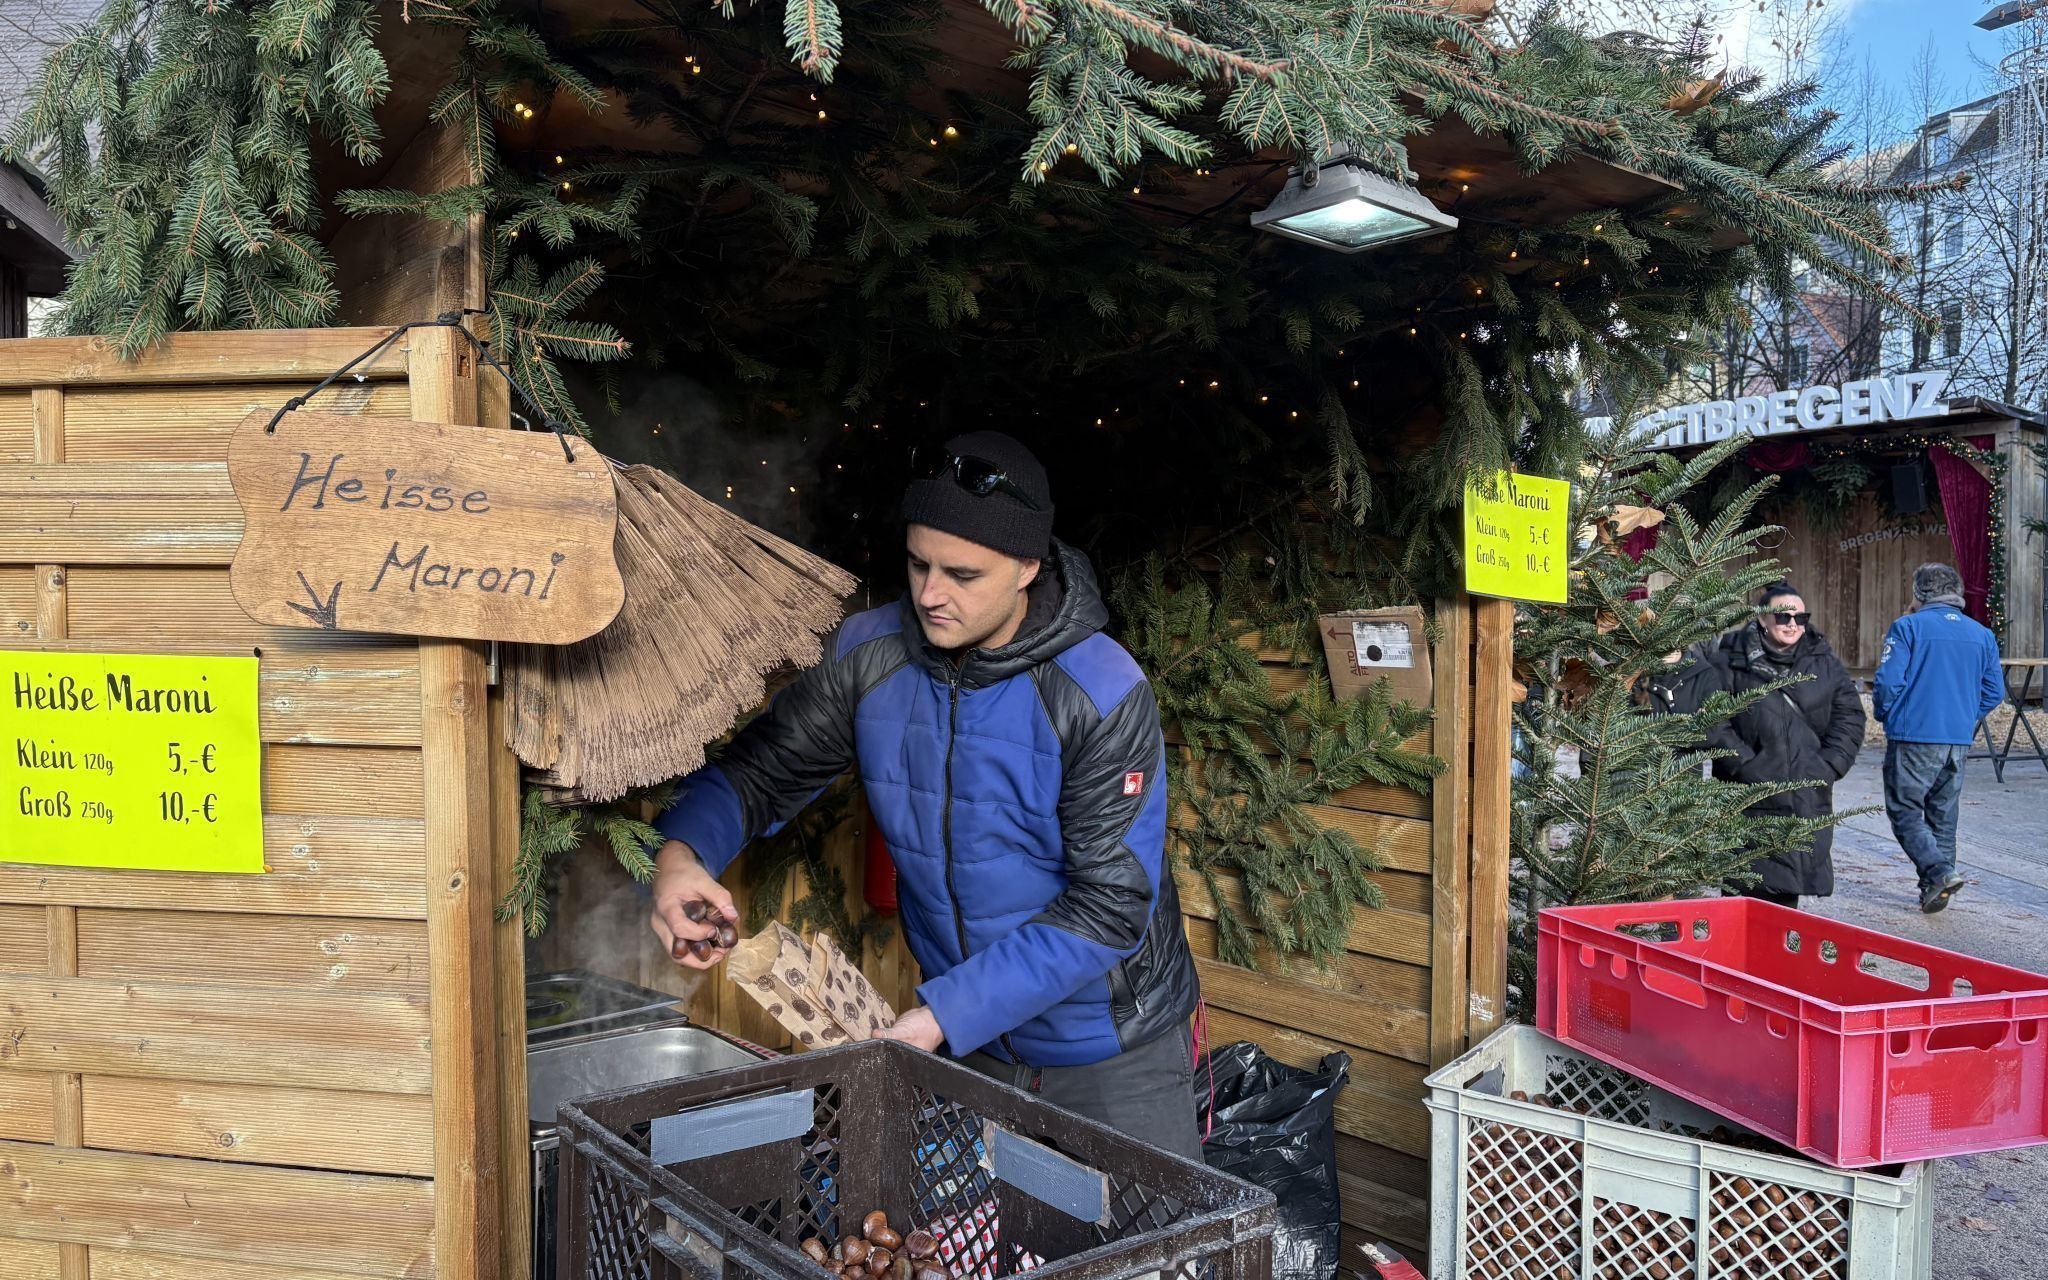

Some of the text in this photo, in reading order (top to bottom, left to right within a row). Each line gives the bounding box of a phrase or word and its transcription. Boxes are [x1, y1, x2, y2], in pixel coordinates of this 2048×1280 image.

[279, 452, 491, 514] Heisse
[1507, 481, 1551, 511] Maroni
[1476, 514, 1550, 545] Klein 120g 5,-€
[1839, 524, 1920, 552] BREGENZER
[368, 540, 566, 600] Maroni
[1476, 544, 1551, 573] Groß 250g 10,-€
[1347, 650, 1359, 676] ALTO
[14, 671, 217, 714] Heiße Maroni
[16, 738, 218, 776] Klein 120g 5,-€
[19, 786, 218, 825] Groß 250g 10,-€
